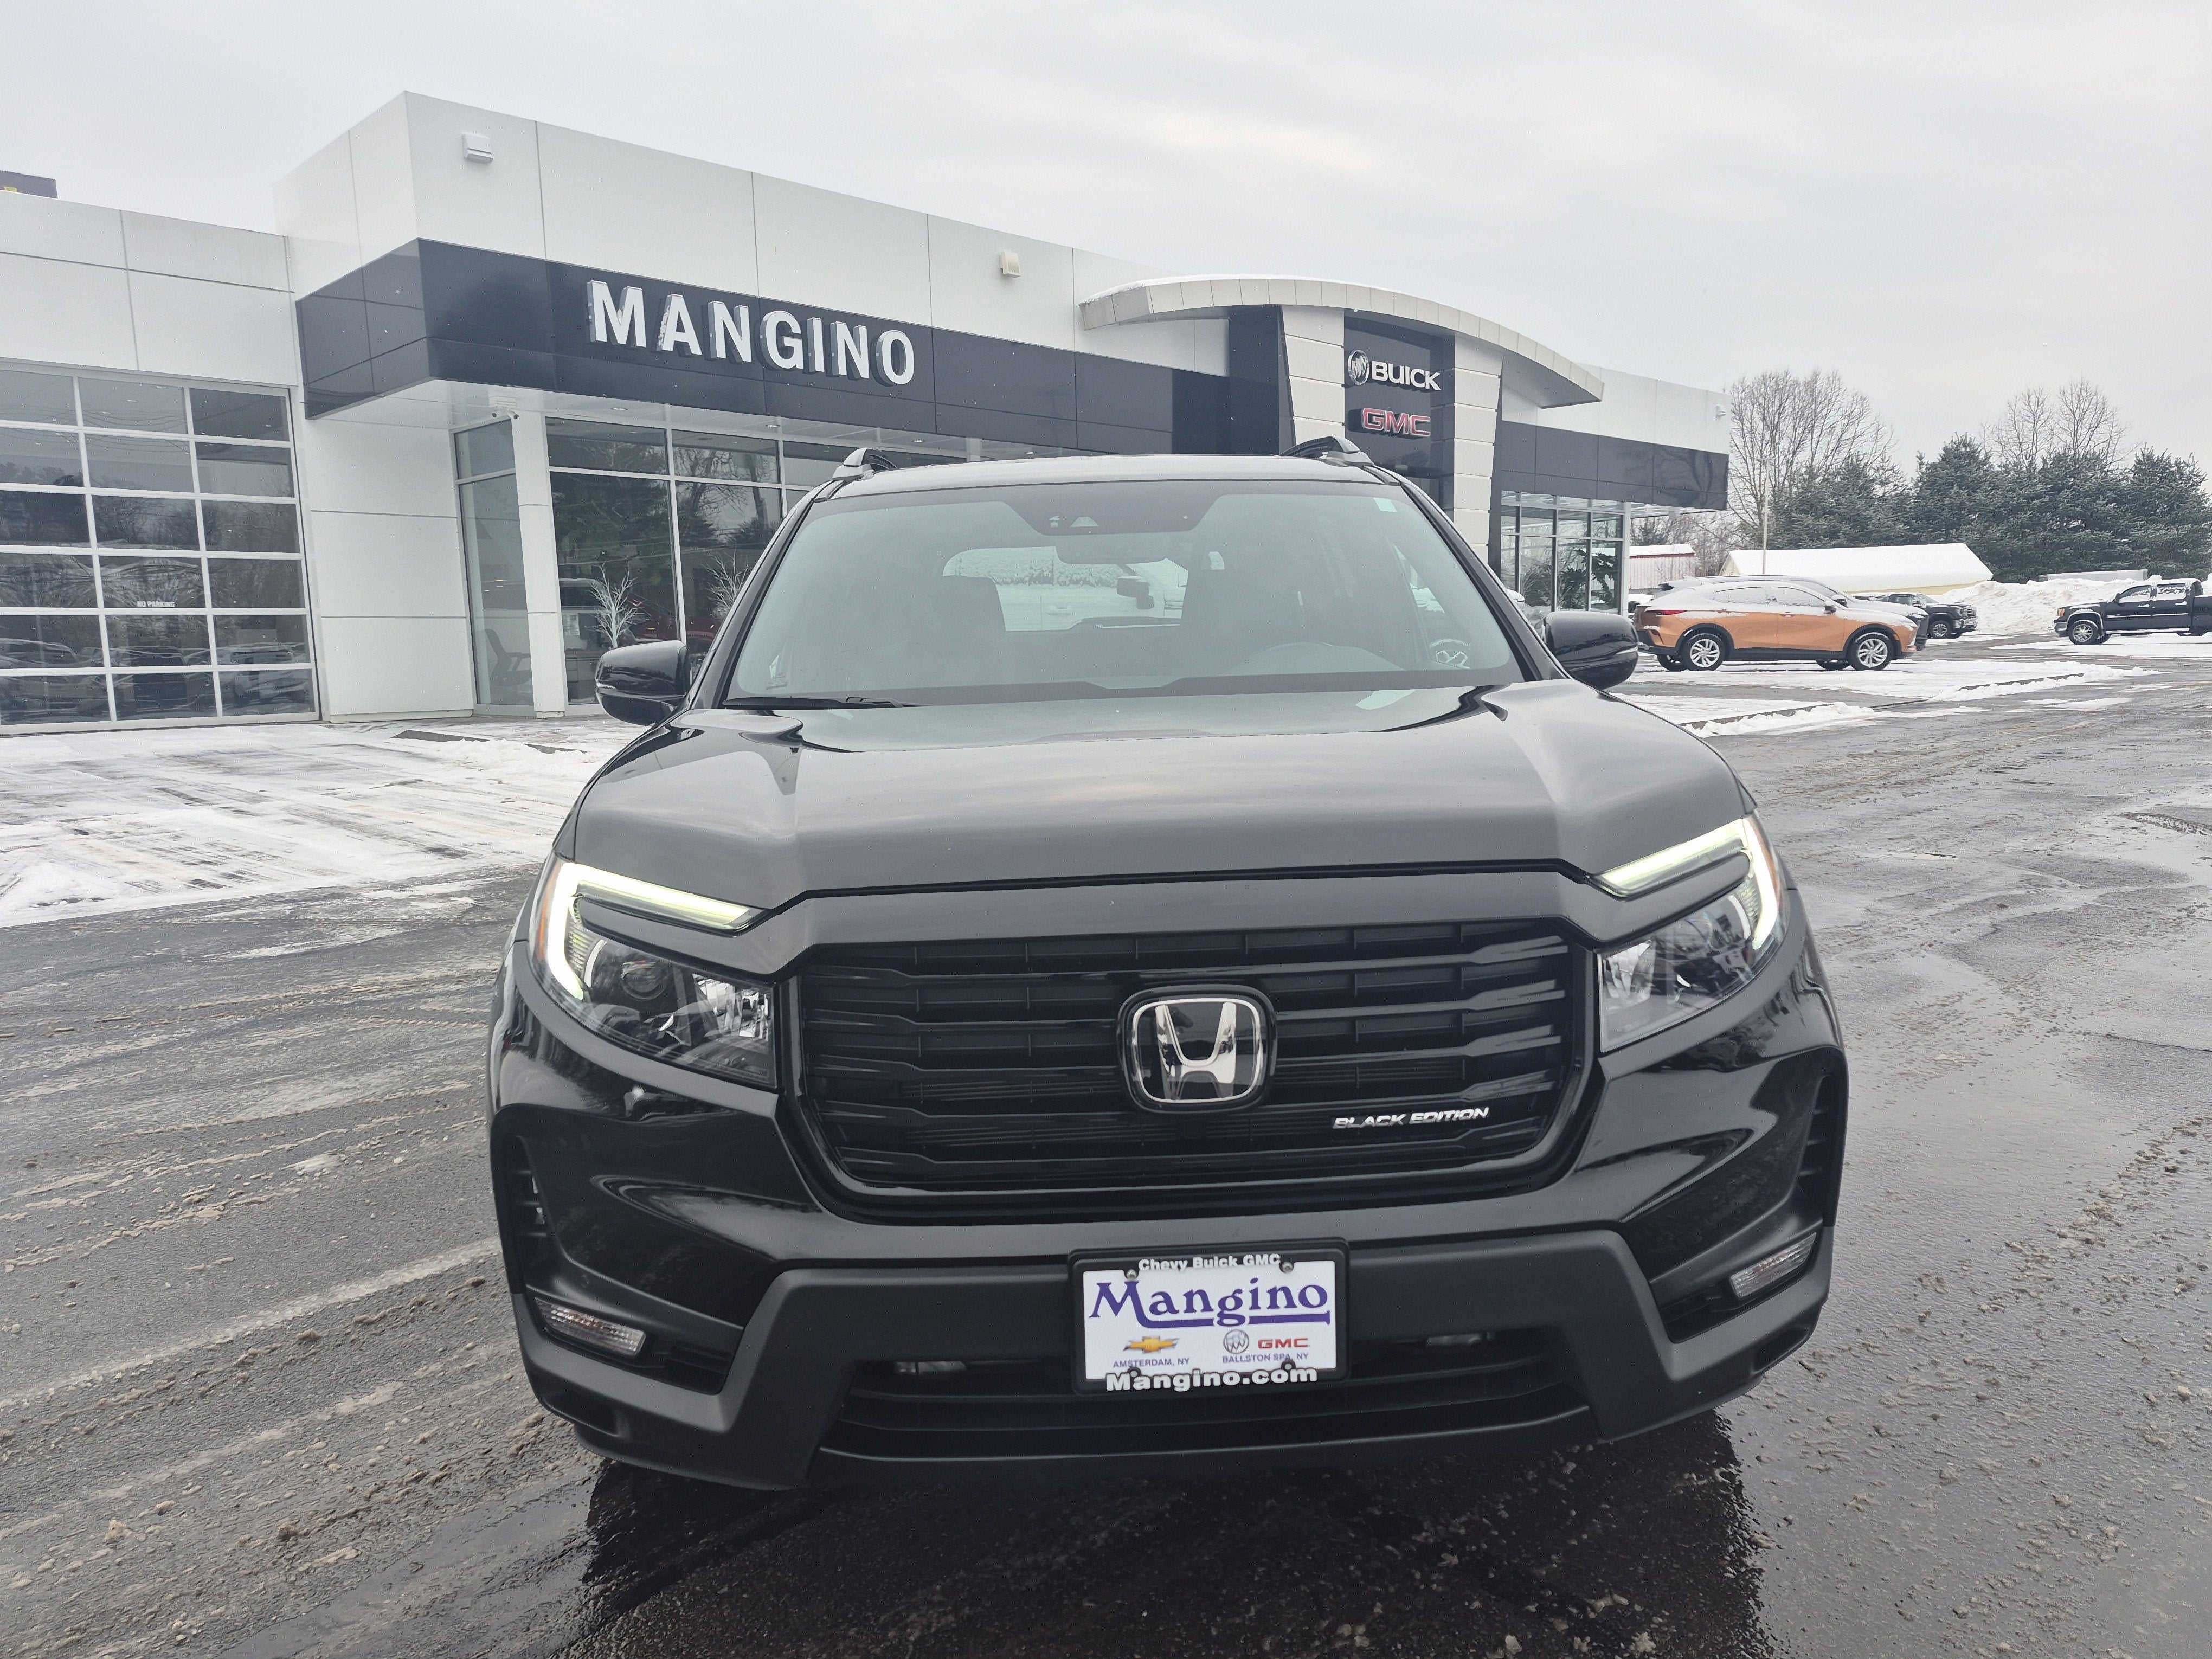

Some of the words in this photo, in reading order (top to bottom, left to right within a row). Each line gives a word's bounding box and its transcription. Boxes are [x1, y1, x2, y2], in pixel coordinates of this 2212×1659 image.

[587, 280, 915, 384] MANGINO
[1371, 361, 1441, 390] BUICK
[1362, 407, 1431, 437] GMC
[1333, 1114, 1407, 1129] BLACK
[1409, 1107, 1489, 1124] EDITION
[1139, 1259, 1188, 1271] Chevy
[1193, 1256, 1238, 1268] Buick
[1243, 1253, 1281, 1266] GMC
[1089, 1278, 1330, 1328] Mangino
[1258, 1338, 1309, 1349] GMC
[1113, 1358, 1175, 1368] AMSTERDAM,
[1222, 1355, 1270, 1364] BALLSTON
[1106, 1368, 1317, 1392] Mangino.com
